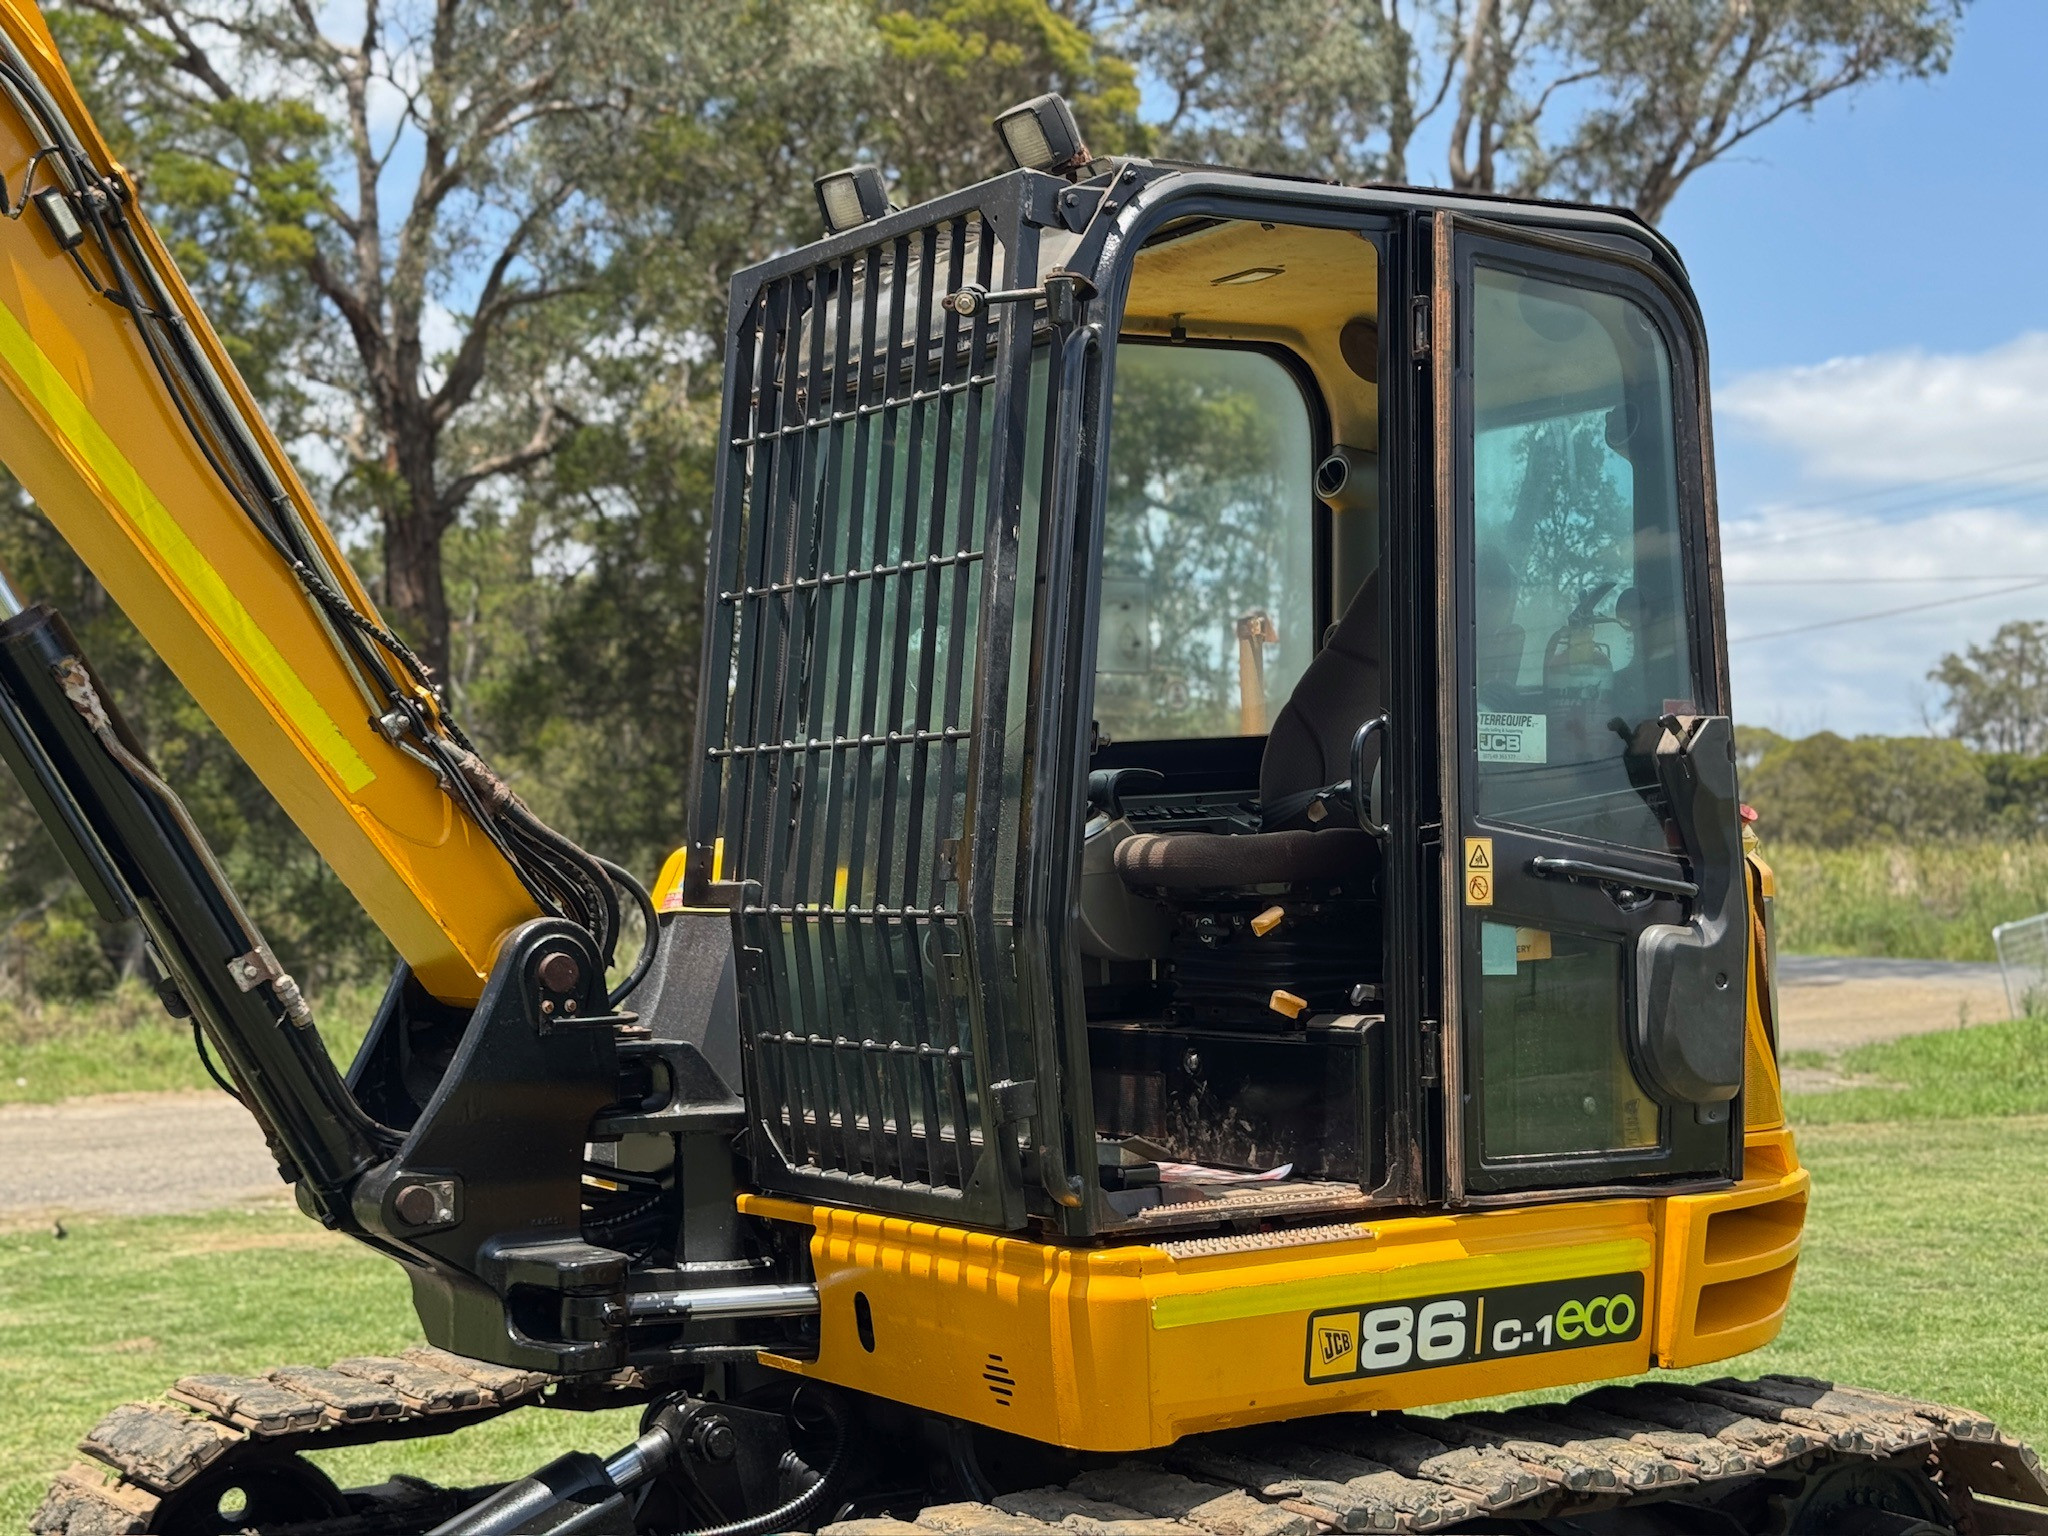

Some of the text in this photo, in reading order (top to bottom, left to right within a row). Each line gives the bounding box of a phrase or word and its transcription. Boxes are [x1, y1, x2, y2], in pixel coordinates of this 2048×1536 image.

[1479, 714, 1532, 727] TERREQUIPE
[1480, 734, 1520, 752] JCB
[1324, 1330, 1351, 1359] JCB
[1360, 1299, 1467, 1370] 86
[1555, 1293, 1636, 1341] eco
